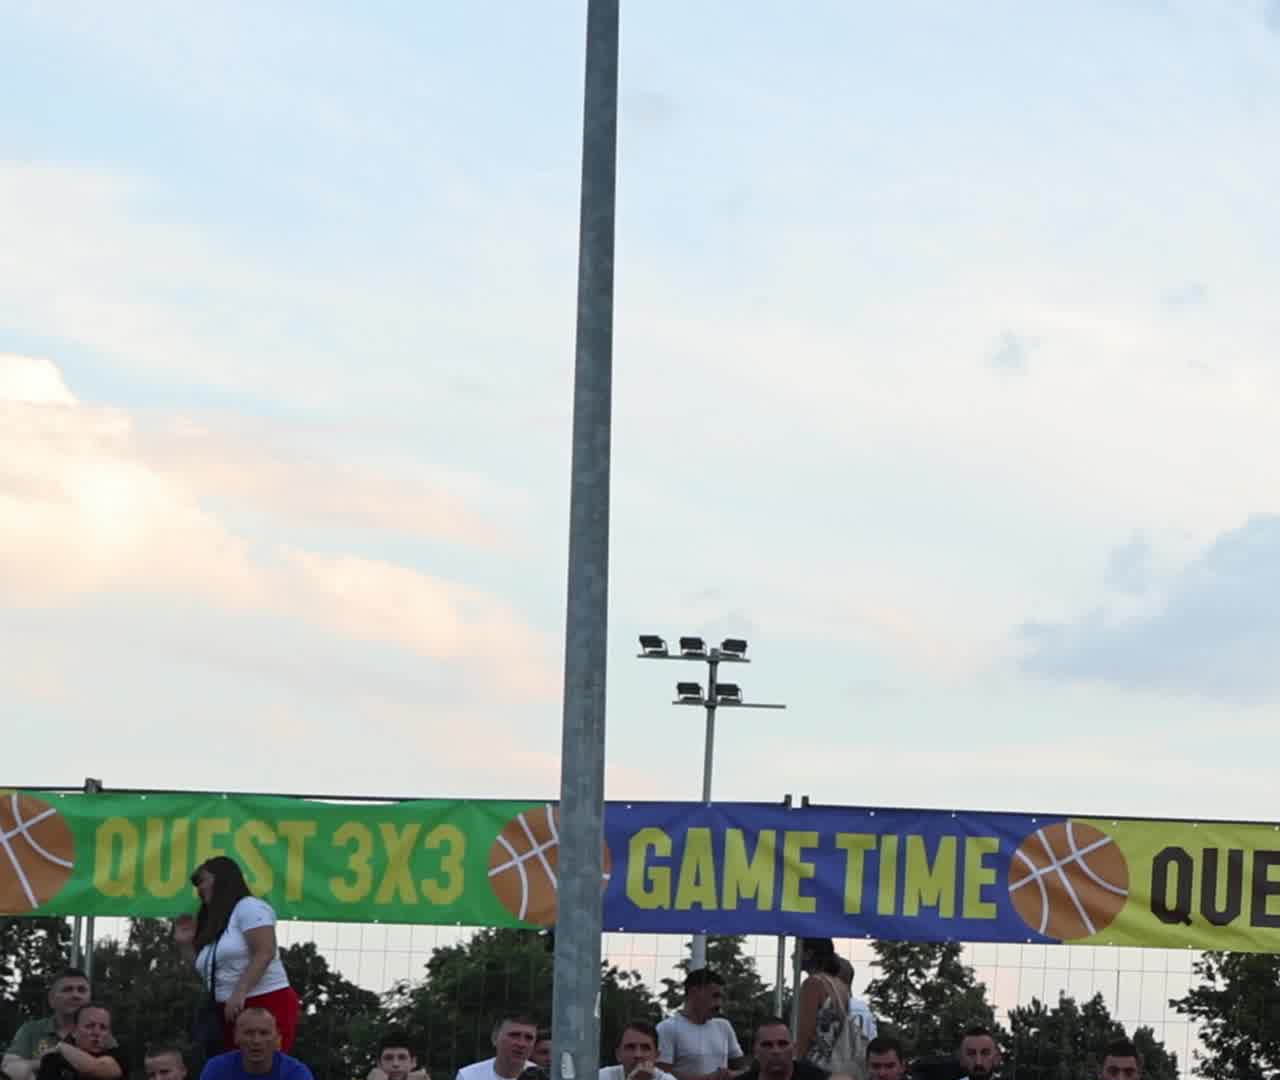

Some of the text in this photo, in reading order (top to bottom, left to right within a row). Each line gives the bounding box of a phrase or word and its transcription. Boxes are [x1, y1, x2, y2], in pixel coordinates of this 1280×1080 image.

[328, 820, 467, 905] 3X3
[626, 827, 1000, 919] GAME TIME
